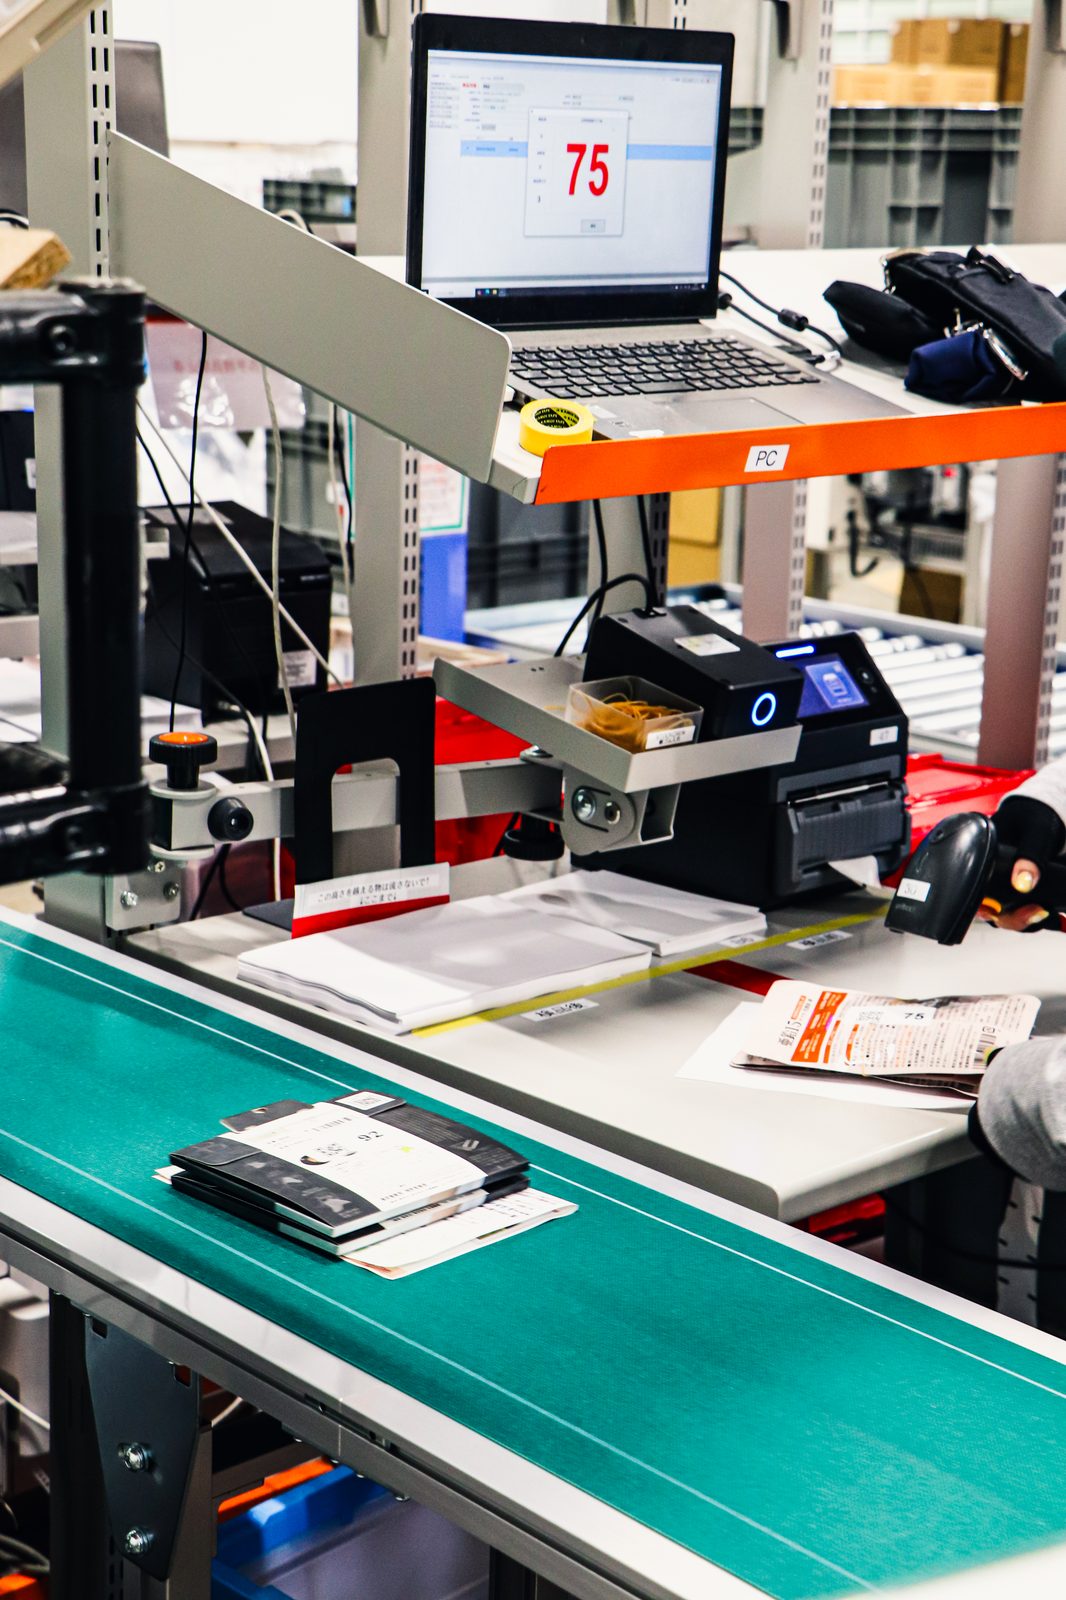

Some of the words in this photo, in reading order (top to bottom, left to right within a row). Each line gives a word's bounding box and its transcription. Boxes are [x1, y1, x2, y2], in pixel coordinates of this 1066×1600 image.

[567, 143, 609, 196] 75
[755, 450, 778, 467] PC
[904, 1011, 926, 1021] 75
[357, 1130, 384, 1142] 92
